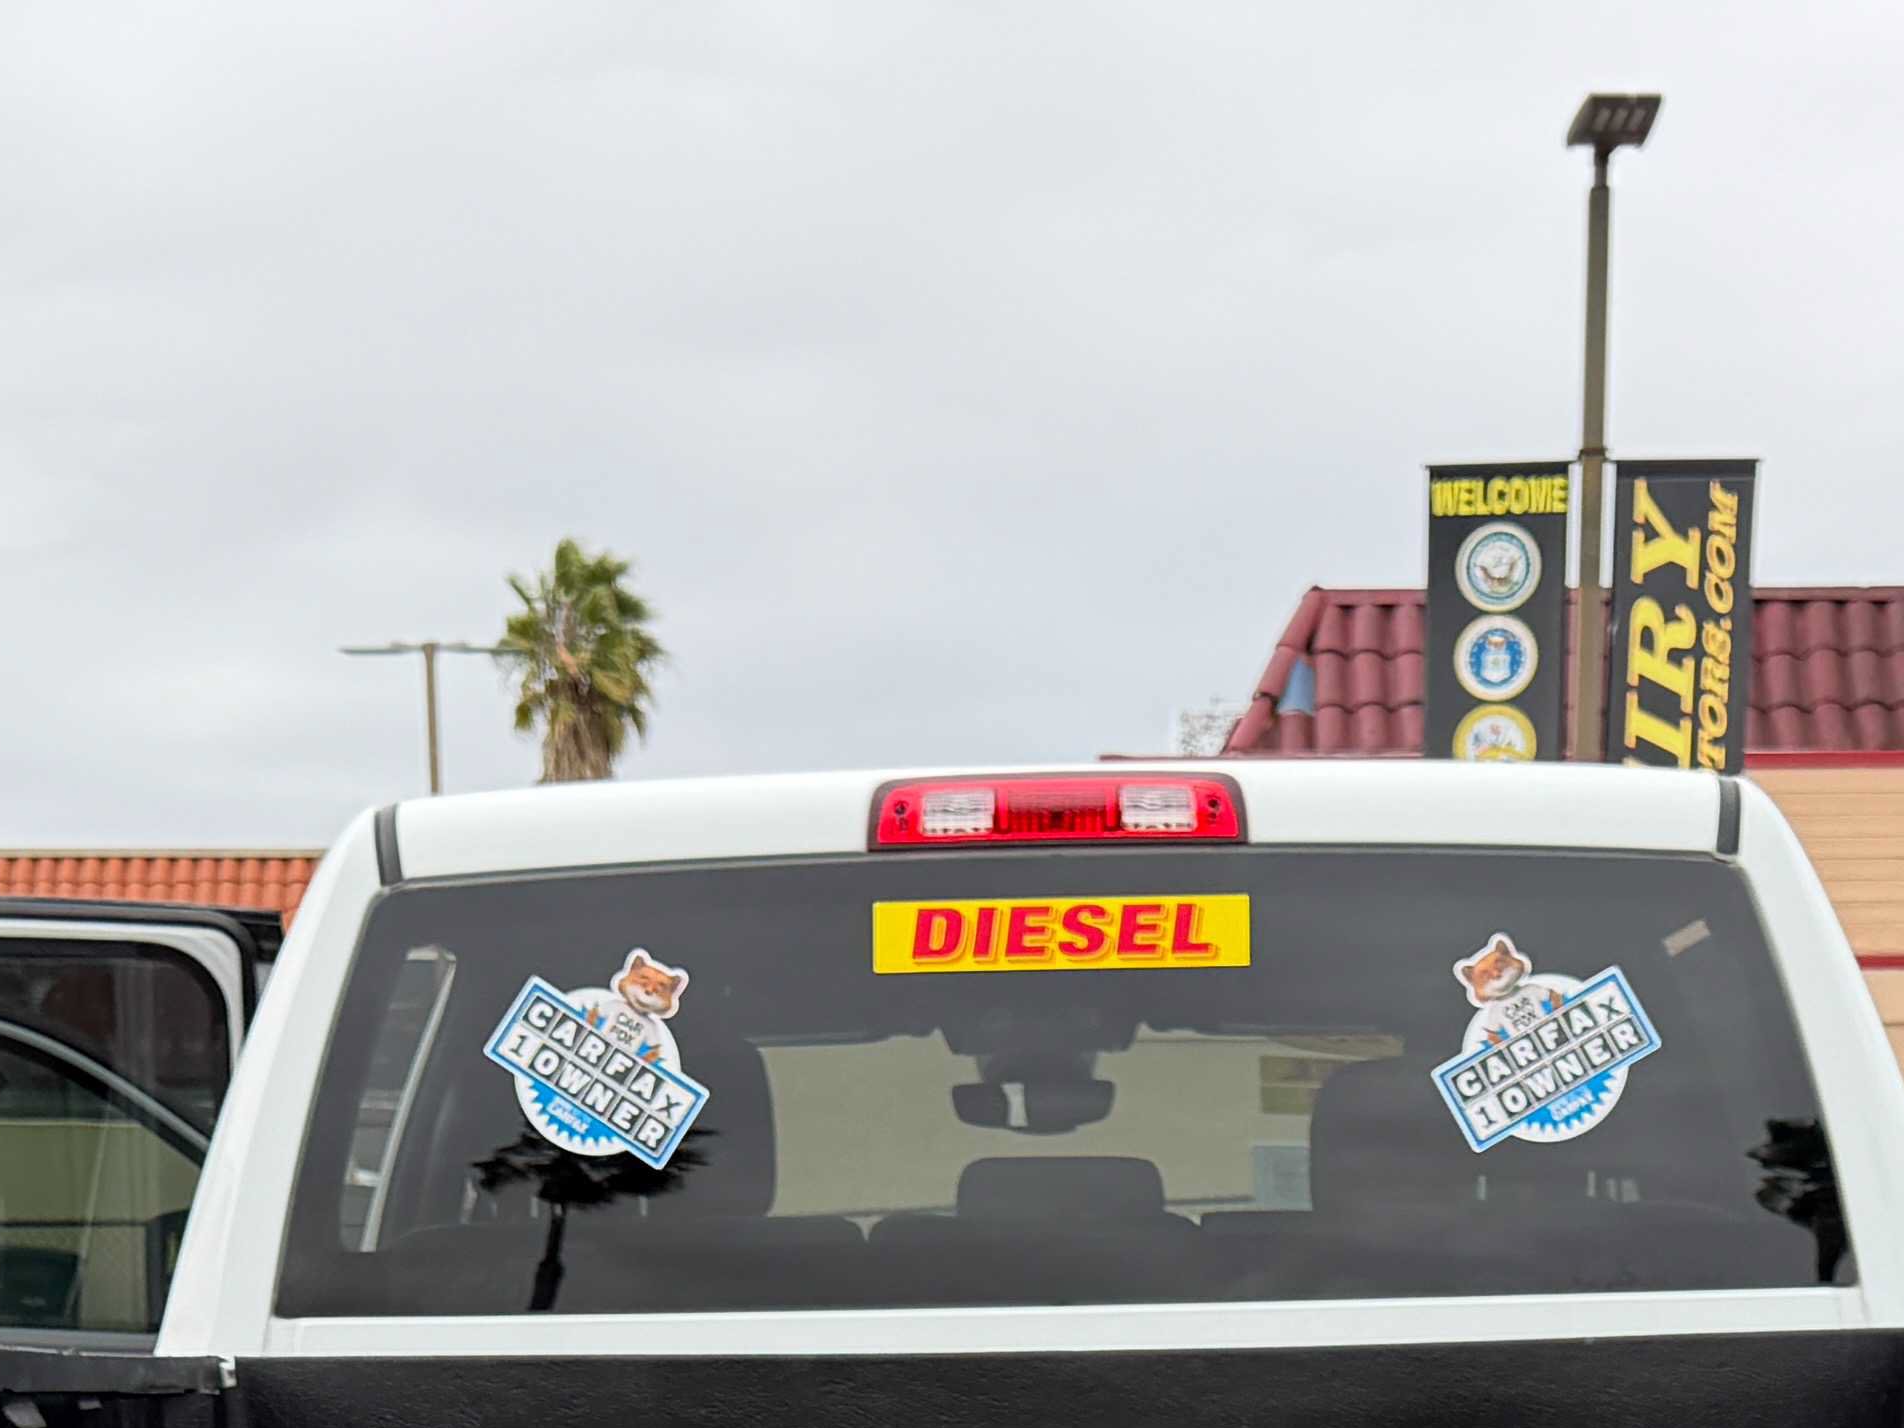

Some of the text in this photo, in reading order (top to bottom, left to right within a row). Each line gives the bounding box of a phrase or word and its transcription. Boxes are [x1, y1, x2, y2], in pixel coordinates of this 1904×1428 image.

[1431, 475, 1569, 516] WELCOME
[1622, 478, 1701, 769] IRY
[1696, 480, 1739, 772] TORS.COM
[912, 903, 1217, 963] DIESEL
[526, 1001, 683, 1125] CARFAX
[1456, 995, 1623, 1098] CARFAX
